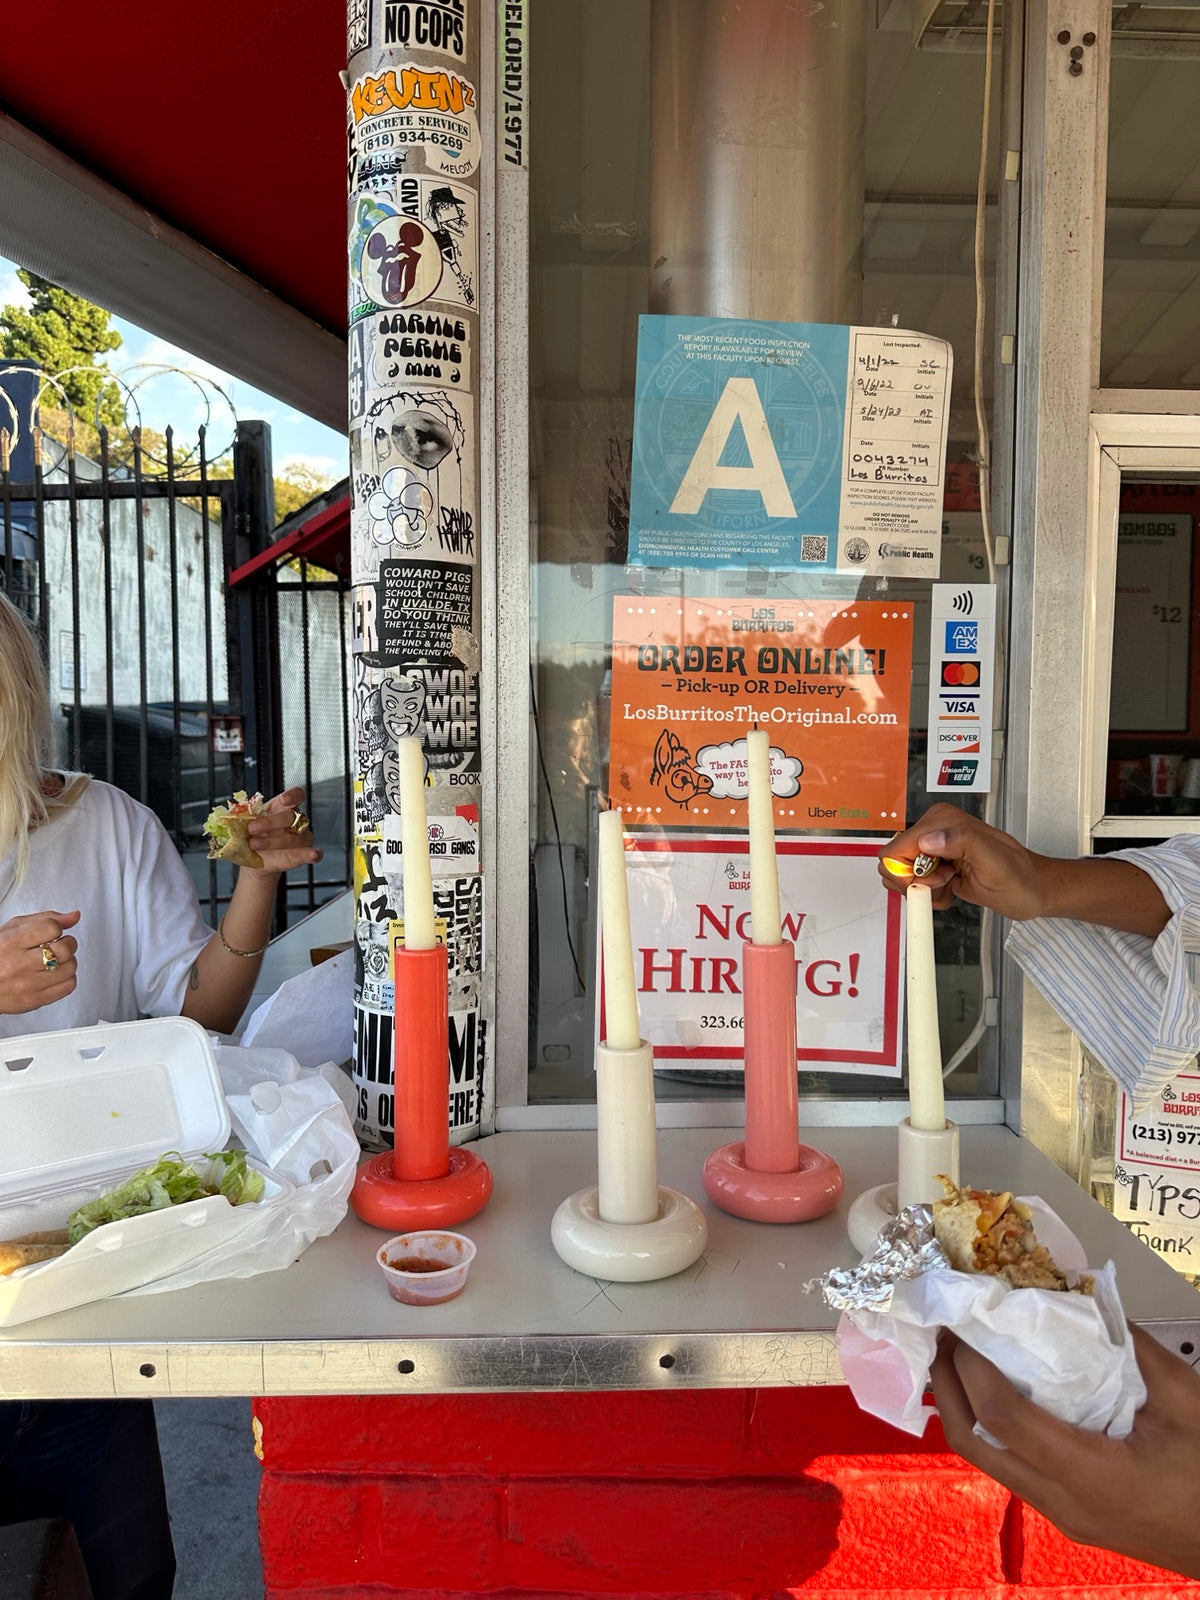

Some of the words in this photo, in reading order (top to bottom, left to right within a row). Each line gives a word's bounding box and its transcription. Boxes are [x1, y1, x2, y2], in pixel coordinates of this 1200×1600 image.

[385, 5, 411, 44] NO
[415, 8, 464, 56] COPS
[502, 0, 523, 166] ELORD/1977
[360, 116, 413, 137] CONCRETE
[419, 116, 469, 136] SERVICES
[364, 133, 394, 154] (818)
[399, 131, 463, 150] 934-6269
[440, 160, 473, 174] MELODY
[401, 179, 419, 217] AND
[716, 336, 743, 344] RECENT
[744, 337, 766, 345] FOOD
[767, 338, 810, 349] INSPECTION
[684, 343, 712, 351] REPORT
[721, 345, 759, 353] AVAILABLE
[776, 348, 803, 357] REVIEW
[713, 354, 744, 362] FACILITY
[744, 355, 766, 363] UPON
[668, 377, 798, 518] A
[853, 454, 928, 466] 0043274
[851, 468, 868, 479] Los
[875, 469, 927, 483] Burritos
[912, 551, 934, 559] Health
[384, 568, 441, 579] COWARD
[444, 571, 471, 584] PIGS
[385, 579, 443, 590] WOULDN'T
[445, 583, 470, 593] SAVE
[385, 589, 423, 598] SCHOOL
[426, 591, 471, 602] CHILDREN
[385, 598, 398, 607] IN
[402, 598, 453, 611] UVALDE,
[457, 603, 471, 613] TX
[384, 610, 401, 619] DO
[404, 610, 431, 620] YOU
[435, 612, 470, 624] THINK
[751, 608, 776, 620] LOS
[384, 621, 420, 629] THEY'LL
[423, 621, 448, 630] SAVE
[732, 620, 794, 633] BURRITOS
[953, 626, 978, 638] AM
[415, 630, 427, 638] IS
[430, 631, 452, 640] TIME
[385, 639, 422, 647] DEFUND
[434, 641, 453, 649] ABO
[956, 638, 977, 649] EX
[402, 648, 440, 656] FUCKING
[637, 645, 747, 676] ORDER
[757, 646, 887, 676] ONLINE!
[676, 678, 740, 696] Pick-up
[744, 680, 770, 694] OR
[774, 680, 846, 697] Delivery
[425, 695, 477, 720] WOE
[944, 702, 975, 713] VISA
[624, 704, 898, 727] LosBurritosTheOriginal.com
[425, 721, 477, 747] WOE
[939, 734, 978, 742] DISCOVER
[709, 761, 728, 770] The
[942, 765, 975, 775] UnionPay
[449, 773, 481, 785] BOOK
[715, 772, 733, 780] way
[808, 807, 837, 818] Uber
[840, 808, 869, 819] Eats
[451, 841, 475, 855] GANGS
[638, 949, 861, 998] HIRG!
[1132, 1124, 1172, 1145] (213)
[1135, 1151, 1163, 1160] balanced
